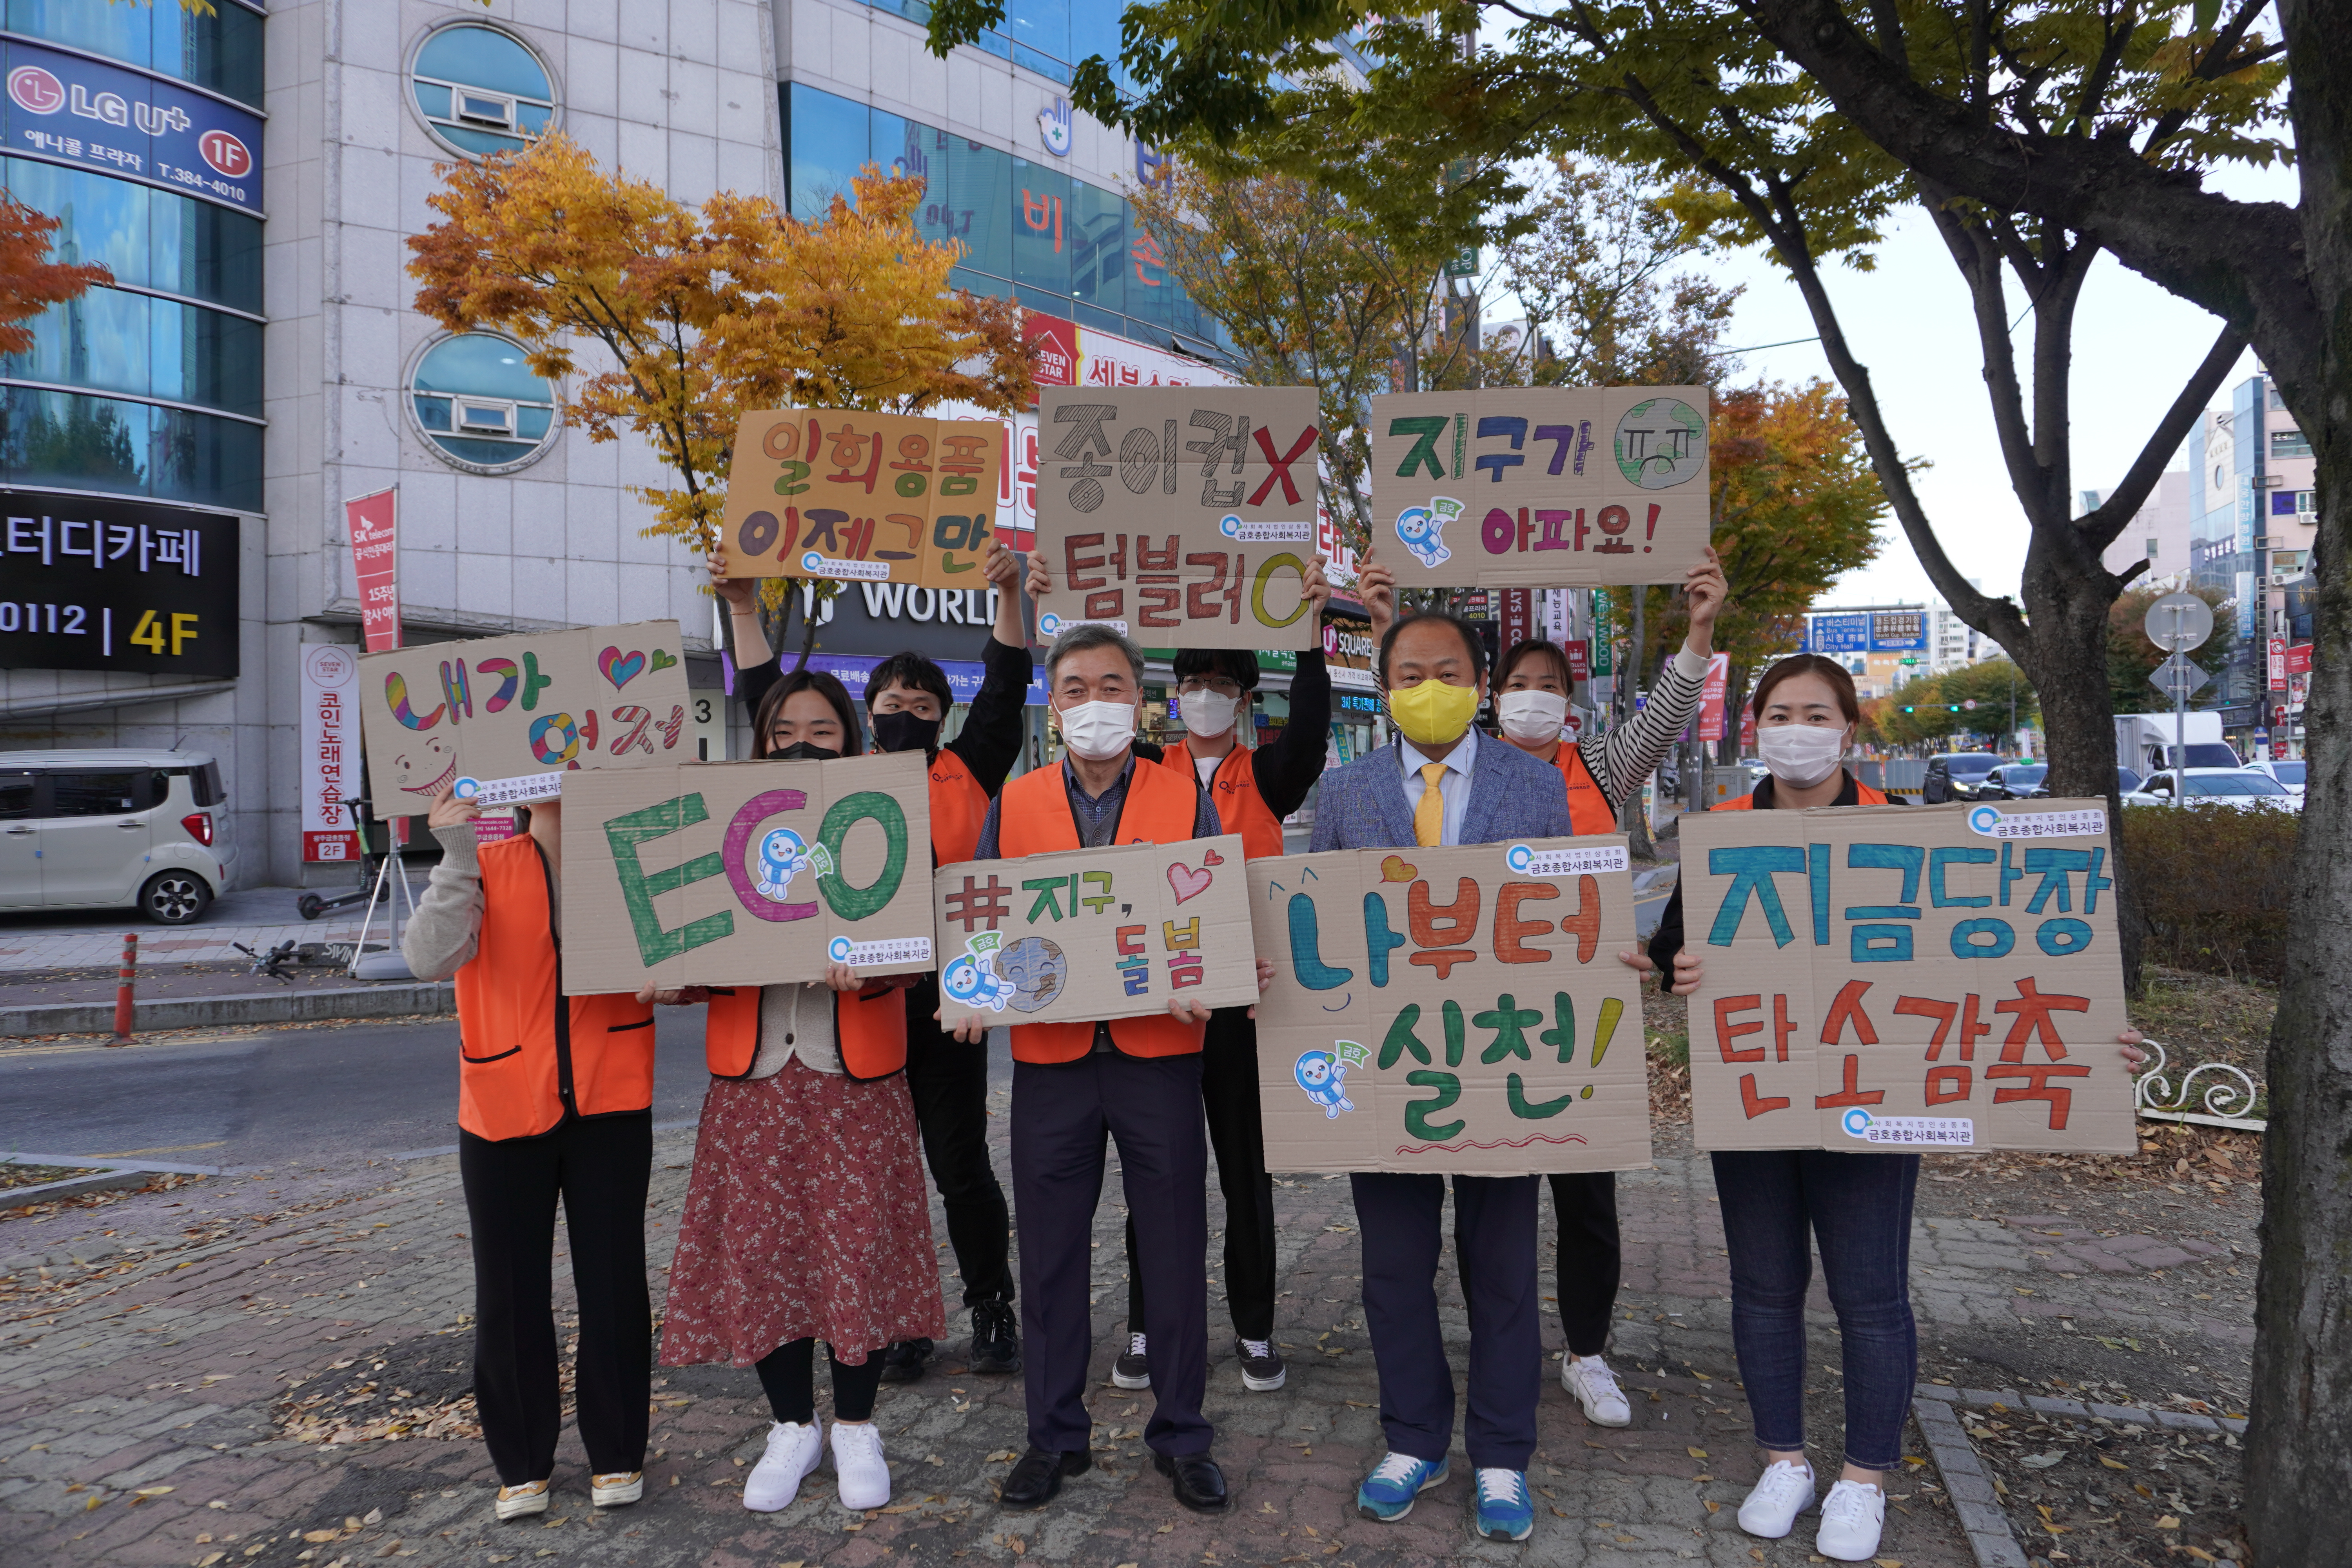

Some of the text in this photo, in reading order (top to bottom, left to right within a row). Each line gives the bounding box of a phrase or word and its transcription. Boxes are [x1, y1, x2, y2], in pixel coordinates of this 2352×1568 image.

[71, 84, 191, 137] LG U+
[24, 130, 143, 172] 애니콜 프라자
[211, 139, 242, 169] 1F
[158, 162, 246, 202] T.384-4010
[763, 418, 989, 498] 일회용품
[1389, 412, 1595, 483] 지구가
[1439, 502, 1455, 514] 금호
[354, 527, 394, 543] SK telecom
[1238, 531, 1310, 540] 금호종합사회복지관
[1481, 503, 1662, 555] 아파요!
[0, 515, 201, 577] 터디카페
[818, 567, 888, 579] 금호종합사회복지관
[363, 608, 382, 625] 감사
[1875, 615, 1920, 625] 월드컵경기장
[130, 610, 199, 656] 4F
[1338, 632, 1372, 657] SQUARE
[1825, 634, 1844, 643] 시청
[1334, 669, 1346, 679] 통신사
[1348, 671, 1356, 680] 가격
[385, 651, 551, 730] 내가
[319, 693, 343, 825] 코인노래연습장
[1997, 821, 2103, 837] 금호종합사회복지관
[323, 845, 341, 856] 2F
[813, 851, 829, 871] 금호
[603, 788, 908, 968] ECO
[1531, 857, 1624, 875] 금호종합사회복지관
[976, 935, 995, 951] 금호
[1288, 873, 1601, 991] 나부터
[849, 948, 929, 965] 금호종합사회복지관
[1116, 916, 1203, 997] 돌봄
[1343, 1044, 1361, 1060] 금호
[1713, 976, 2091, 1131] 탄소감축
[1377, 991, 1624, 1141] 실천!
[1868, 1129, 1971, 1142] 금호종합사회복지관
